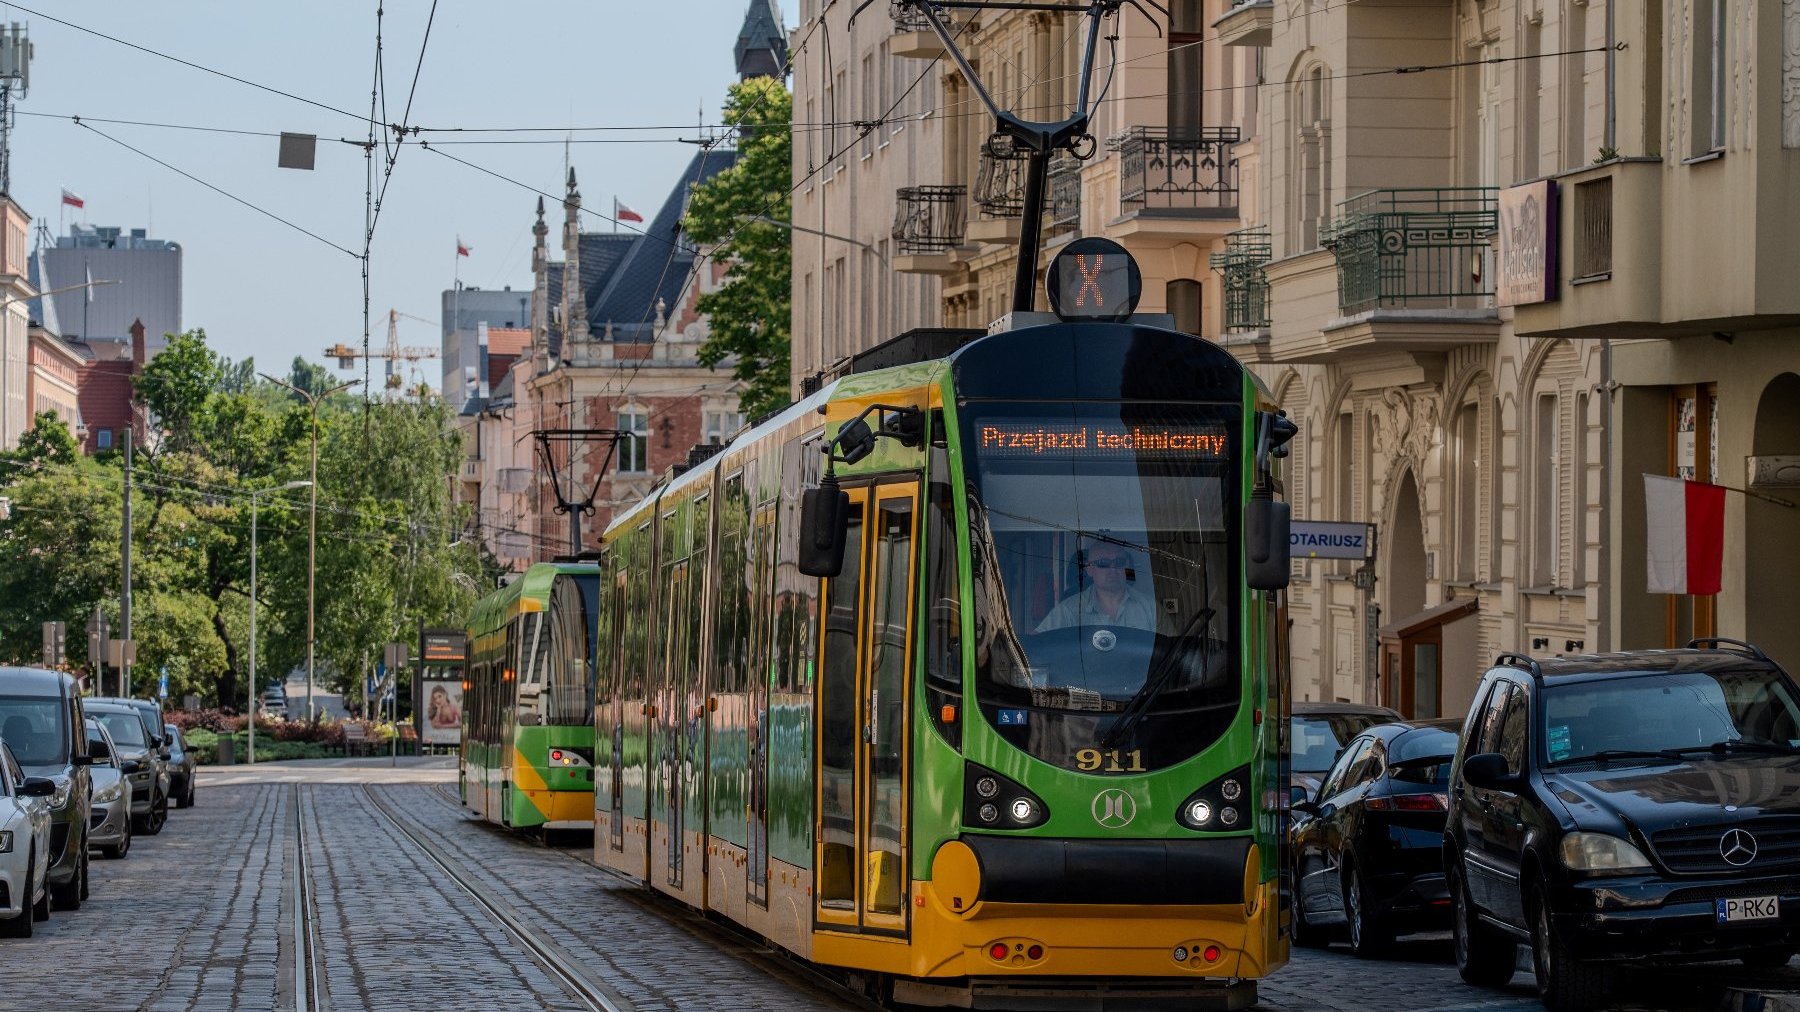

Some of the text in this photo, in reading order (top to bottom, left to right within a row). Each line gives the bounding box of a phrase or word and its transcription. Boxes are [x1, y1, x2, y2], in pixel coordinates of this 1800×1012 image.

[1076, 254, 1103, 306] X
[982, 427, 1227, 455] Przejazd techniczny
[1075, 749, 1147, 772] 911
[1727, 899, 1776, 919] P RK6
